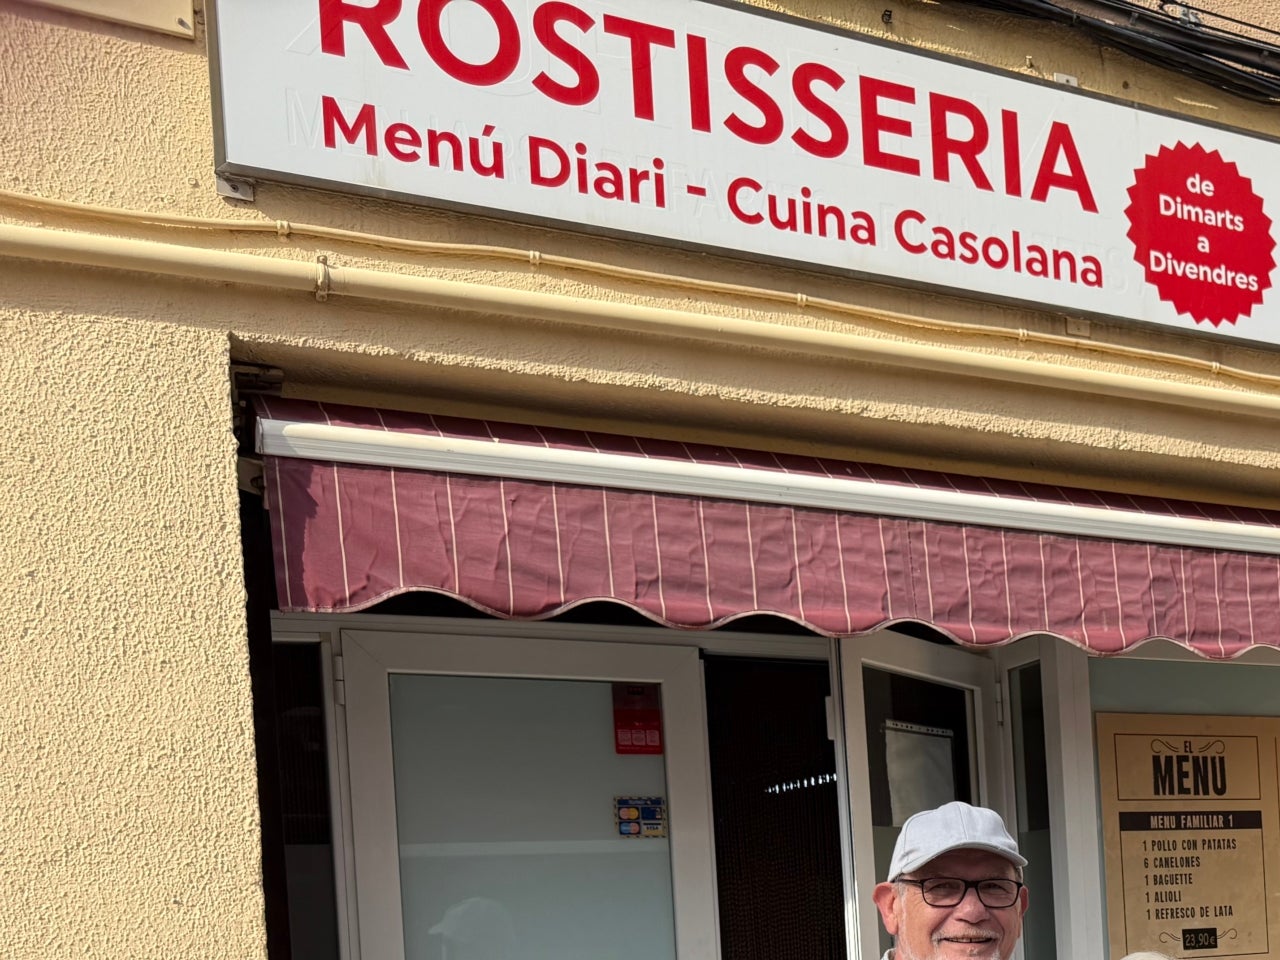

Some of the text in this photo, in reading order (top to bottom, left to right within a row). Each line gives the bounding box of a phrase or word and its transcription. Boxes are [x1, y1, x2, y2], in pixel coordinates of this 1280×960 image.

[1186, 172, 1215, 195] de
[321, 95, 504, 180] Menú
[528, 136, 666, 209] Diari
[727, 176, 876, 246] Cuina
[894, 209, 1103, 289] Casolana
[1159, 193, 1245, 233] Dimarts
[1197, 235, 1210, 254] a
[1149, 250, 1259, 293] Divendres
[1184, 740, 1194, 754] EL
[1150, 814, 1233, 829] MENU FAMILIAR 1
[1143, 838, 1237, 852] 1 POLLO CON PATATAS
[1143, 856, 1201, 869] 6 CANELONES
[1144, 873, 1193, 886] 1 BAGUETTE
[1145, 890, 1182, 903] 1 ALIOLI
[1146, 905, 1234, 920] 1 REFRESCO DE LATA
[1185, 932, 1216, 948] 23,90€
